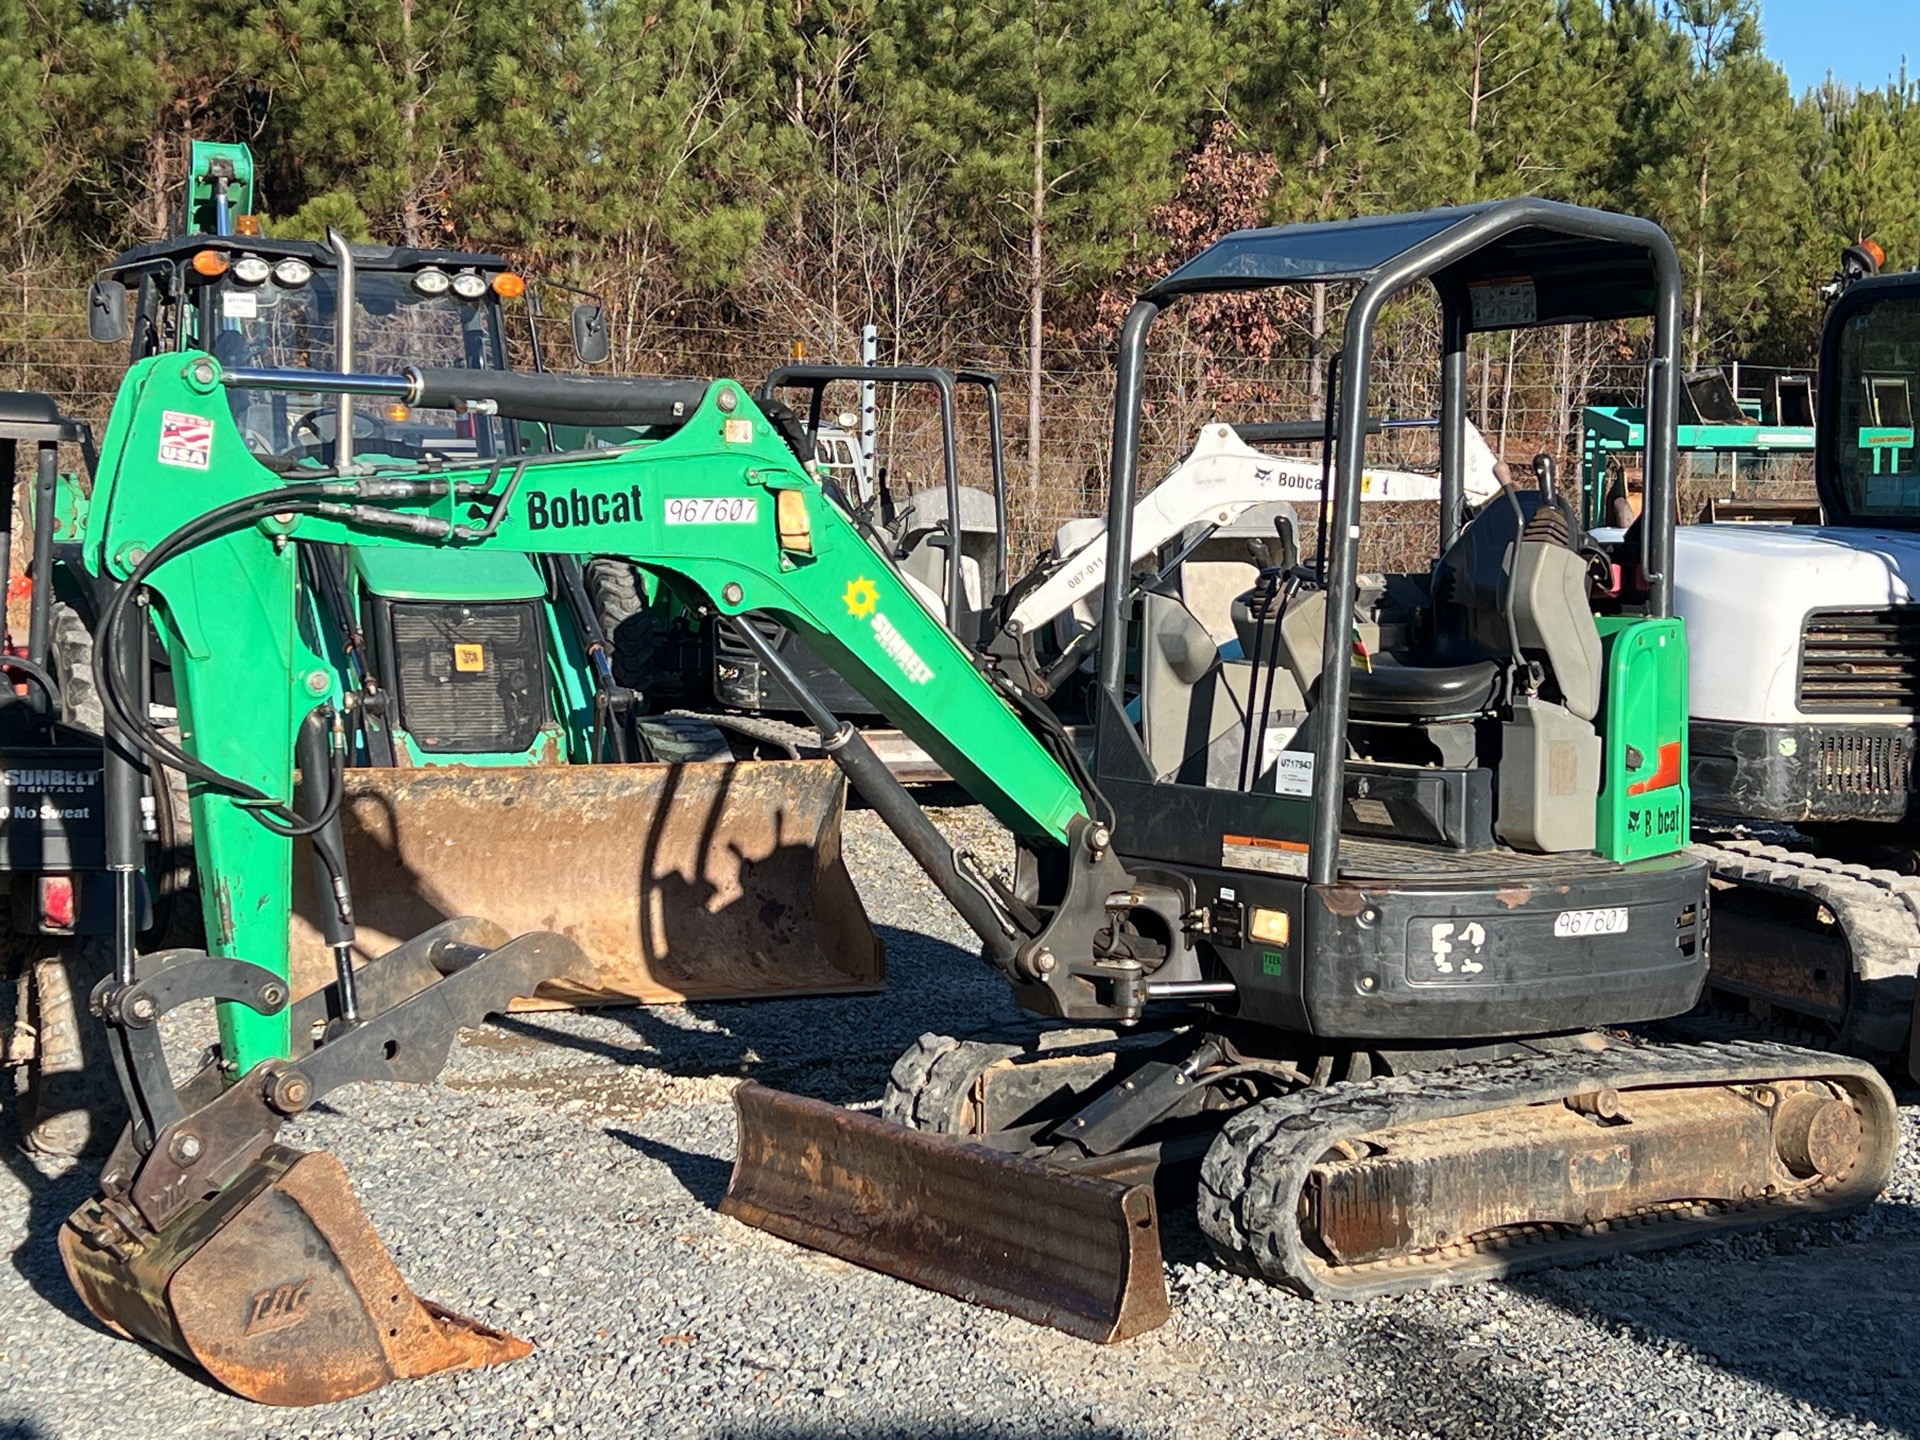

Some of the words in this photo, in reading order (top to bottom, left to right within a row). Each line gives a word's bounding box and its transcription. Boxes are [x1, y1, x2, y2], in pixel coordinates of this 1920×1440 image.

[161, 445, 207, 466] USA
[1279, 471, 1322, 490] Bobca
[526, 484, 643, 530] Bobcat
[669, 498, 757, 522] 967607
[1067, 556, 1105, 589] 087-011
[870, 612, 936, 686] SUNBELT
[4, 769, 99, 786] SUNBELT
[17, 785, 85, 793] RENTALS
[14, 806, 37, 819] No
[40, 804, 90, 820] Sweat
[1559, 909, 1628, 934] 967607
